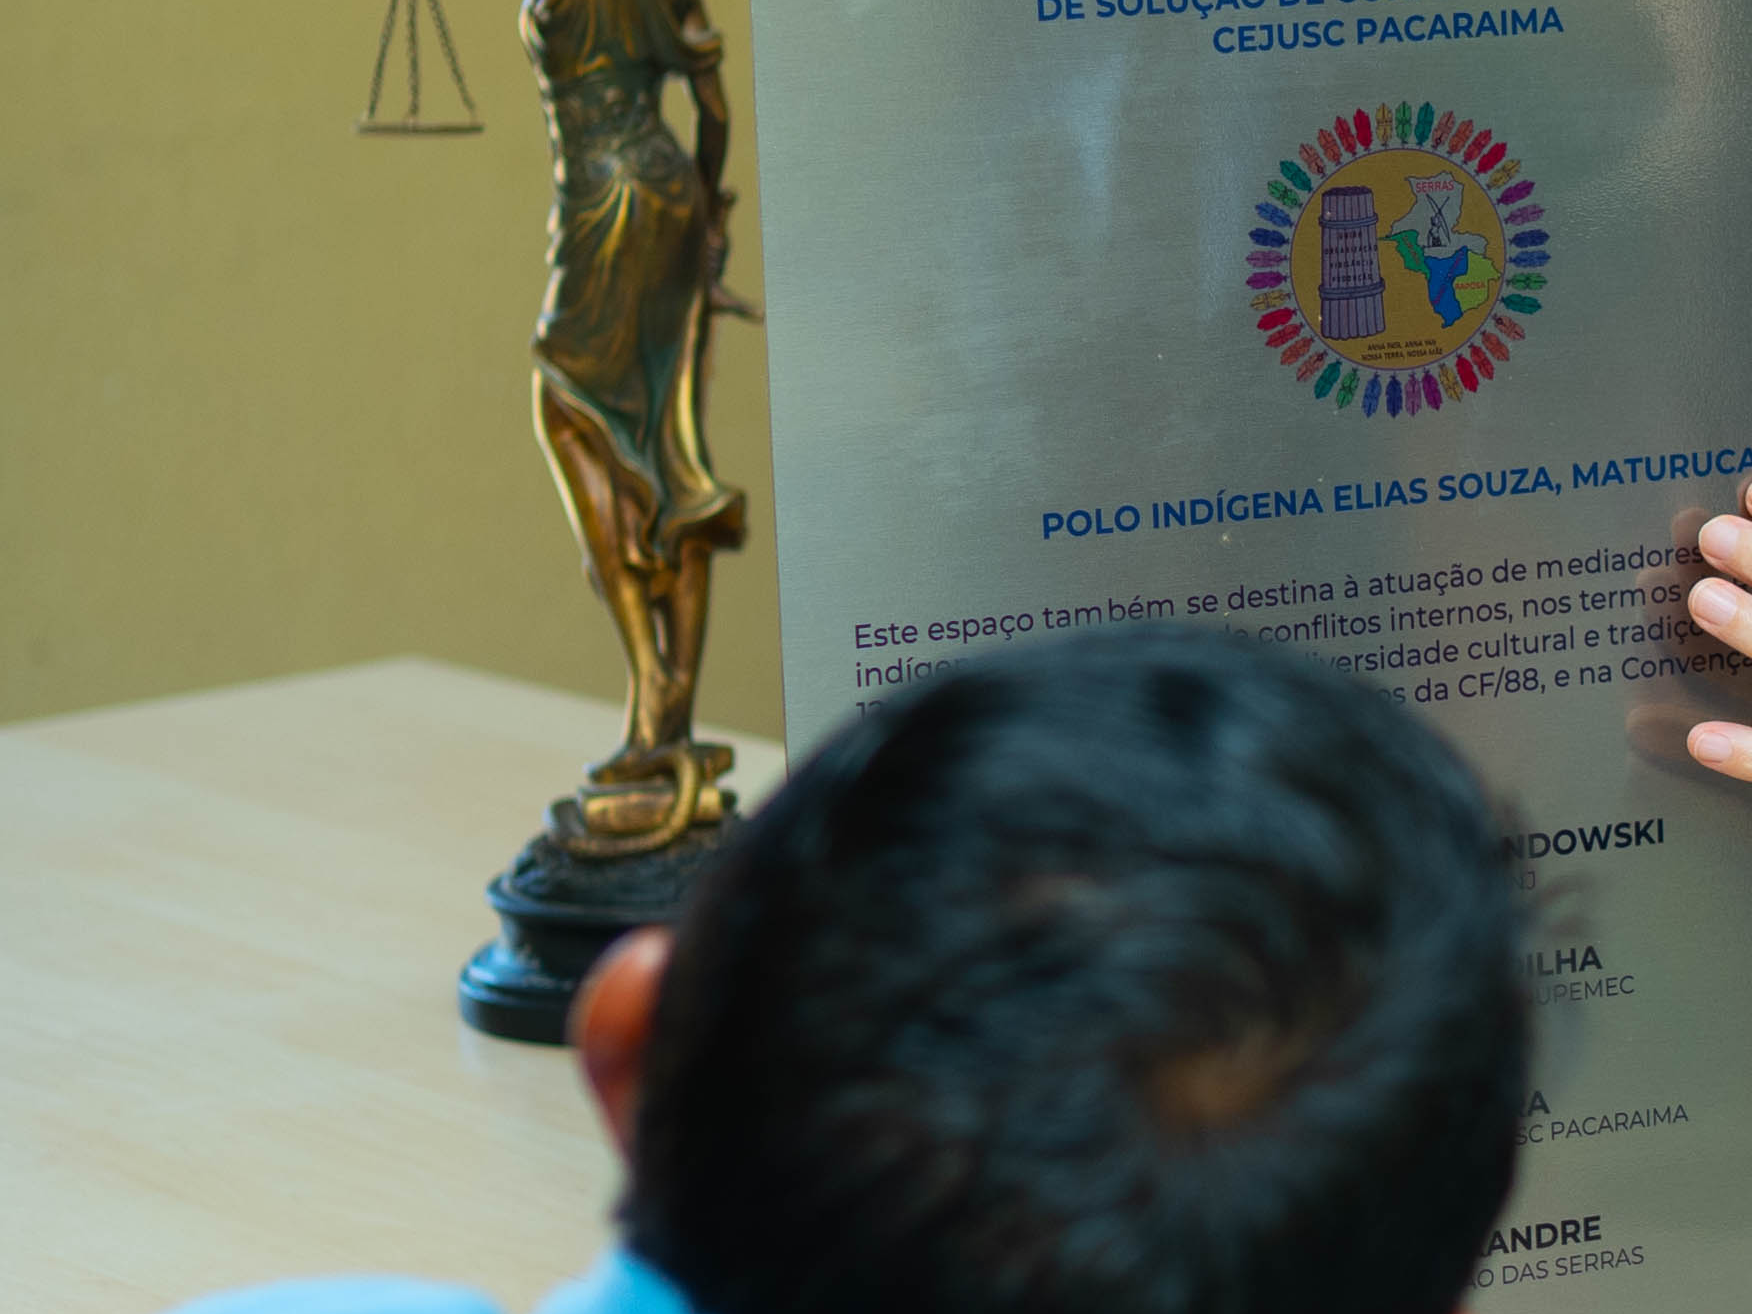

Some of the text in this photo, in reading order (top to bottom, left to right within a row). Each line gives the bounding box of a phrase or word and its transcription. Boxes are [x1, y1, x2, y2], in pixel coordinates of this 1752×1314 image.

[1212, 6, 1565, 55] CEJUSC PACARAIMA
[1415, 180, 1455, 194] SERRAS
[1042, 504, 1141, 541] POLO
[1151, 488, 1324, 529] INDÍGENA
[1333, 477, 1428, 512] ELIAS
[1437, 466, 1562, 503] SOUZA,
[854, 543, 1704, 649] Este espaço também se destina à atuação de mediadores
[1258, 611, 1382, 645] conflitos
[1389, 599, 1514, 632] internos,
[1522, 593, 1572, 618] nos
[1579, 582, 1682, 612] termos
[1467, 624, 1575, 661] cultural
[1583, 628, 1600, 648] e
[1413, 677, 1449, 703] da
[1457, 665, 1547, 699] CF/88,
[1554, 667, 1570, 688] e
[1579, 661, 1612, 686] na
[1505, 817, 1665, 860] NDOWSKI
[1534, 975, 1635, 1006] UPEMEC
[1550, 1103, 1689, 1141] PACARAIMA
[1480, 1215, 1602, 1258] ANDRE
[1501, 1259, 1549, 1285] DAS
[1554, 1245, 1645, 1277] SERRAS
